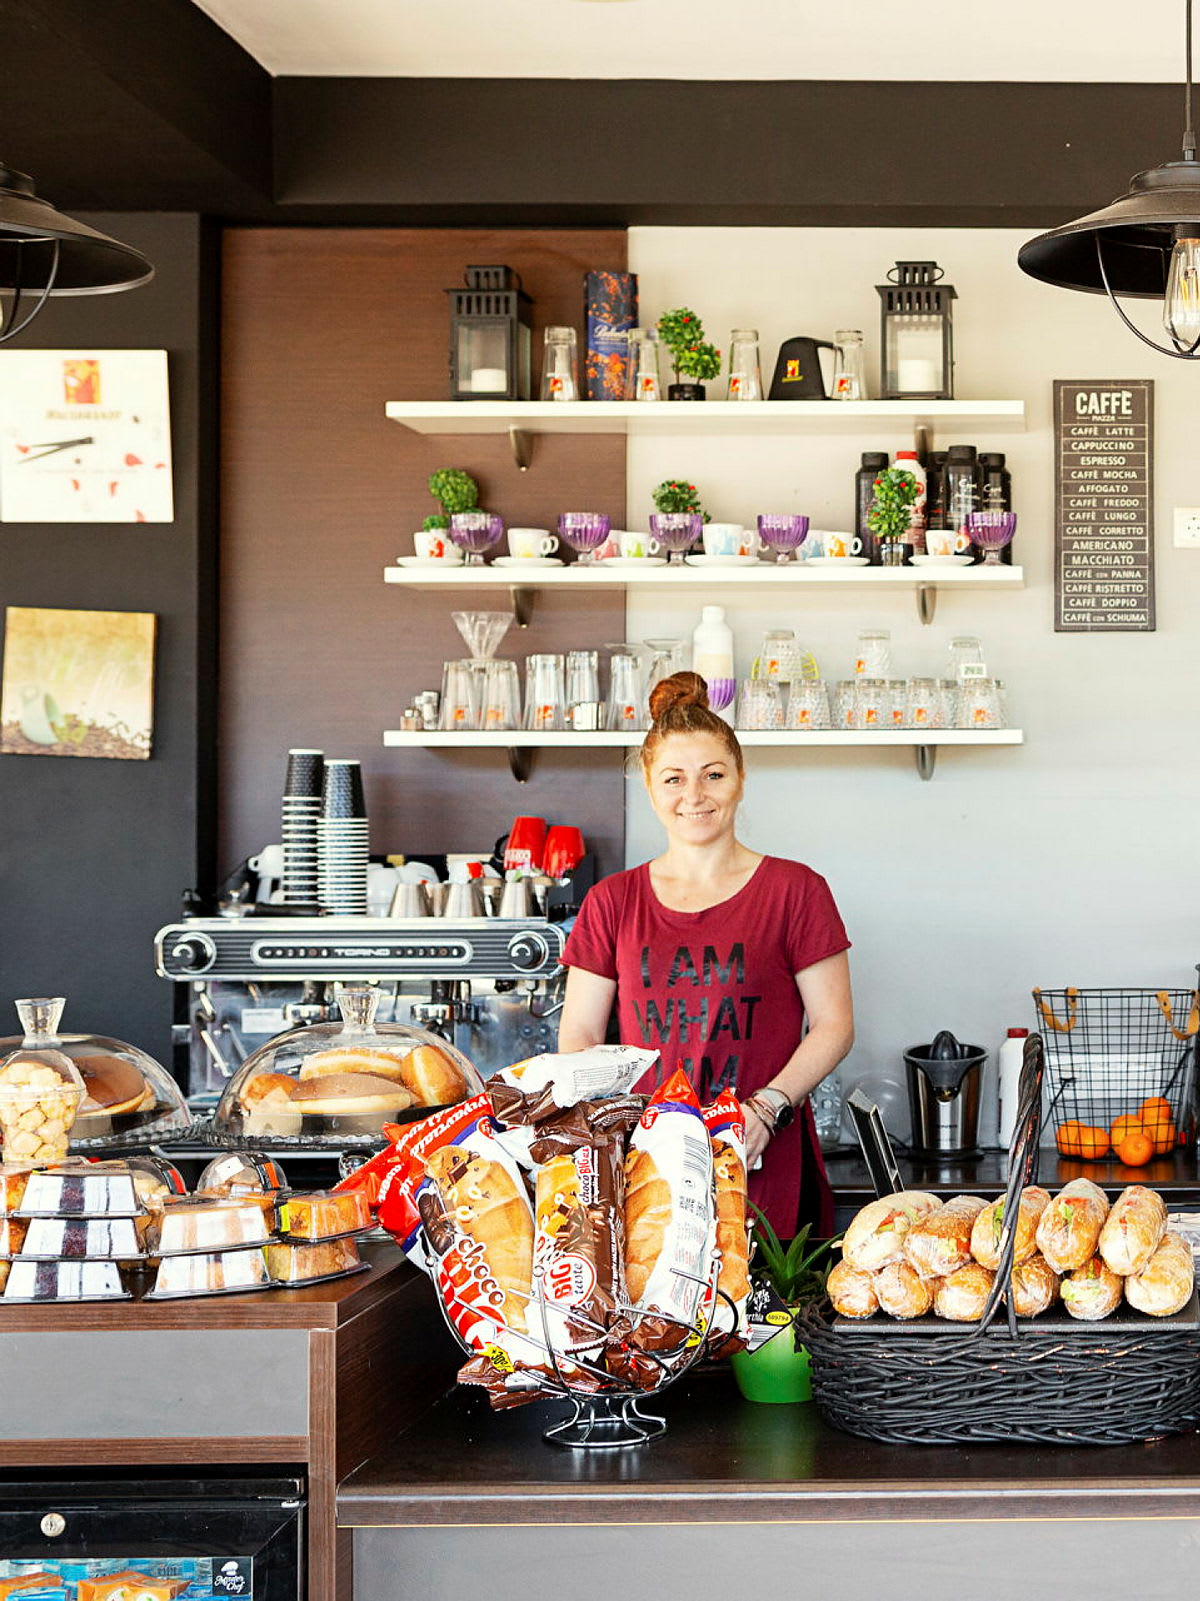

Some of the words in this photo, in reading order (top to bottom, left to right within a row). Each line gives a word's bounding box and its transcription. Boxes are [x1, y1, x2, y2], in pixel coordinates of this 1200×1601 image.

[1075, 389, 1133, 415] CAFFÈ
[1071, 427, 1099, 436] CAFFÈ
[1106, 427, 1135, 436] LATTE
[1071, 441, 1135, 451] CAPPUCCINO
[1080, 456, 1126, 466] ESPRESSO
[1071, 470, 1099, 479] CAFFÈ
[1103, 470, 1138, 479] MOCHA
[1078, 484, 1129, 493] AFFOGATO
[1070, 498, 1098, 507] CAFFÈ
[1104, 498, 1140, 507] FREDDO
[1068, 512, 1096, 521] CAFFÈ
[1104, 512, 1137, 521] LUNGO
[1066, 526, 1093, 535] CAFFÈ
[1099, 526, 1144, 535] CORRETTO
[1072, 541, 1134, 550] AMERICANO
[1072, 555, 1135, 565] MACCHIATO
[1065, 569, 1093, 579] CAFFÈ
[1111, 570, 1142, 579] PANNA
[1095, 584, 1144, 594] RISTRETTO
[1069, 598, 1096, 607] CAFFÈ
[1102, 598, 1138, 607] DOPPIO
[1064, 612, 1092, 622] CAFFÈ
[1107, 613, 1146, 622] SCHIUMA
[640, 946, 652, 988] I
[667, 943, 745, 988] AM
[632, 996, 762, 1044] WHAT
[457, 1238, 505, 1307] choco
[550, 1262, 573, 1300] BIG
[225, 1581, 246, 1594] Chef
